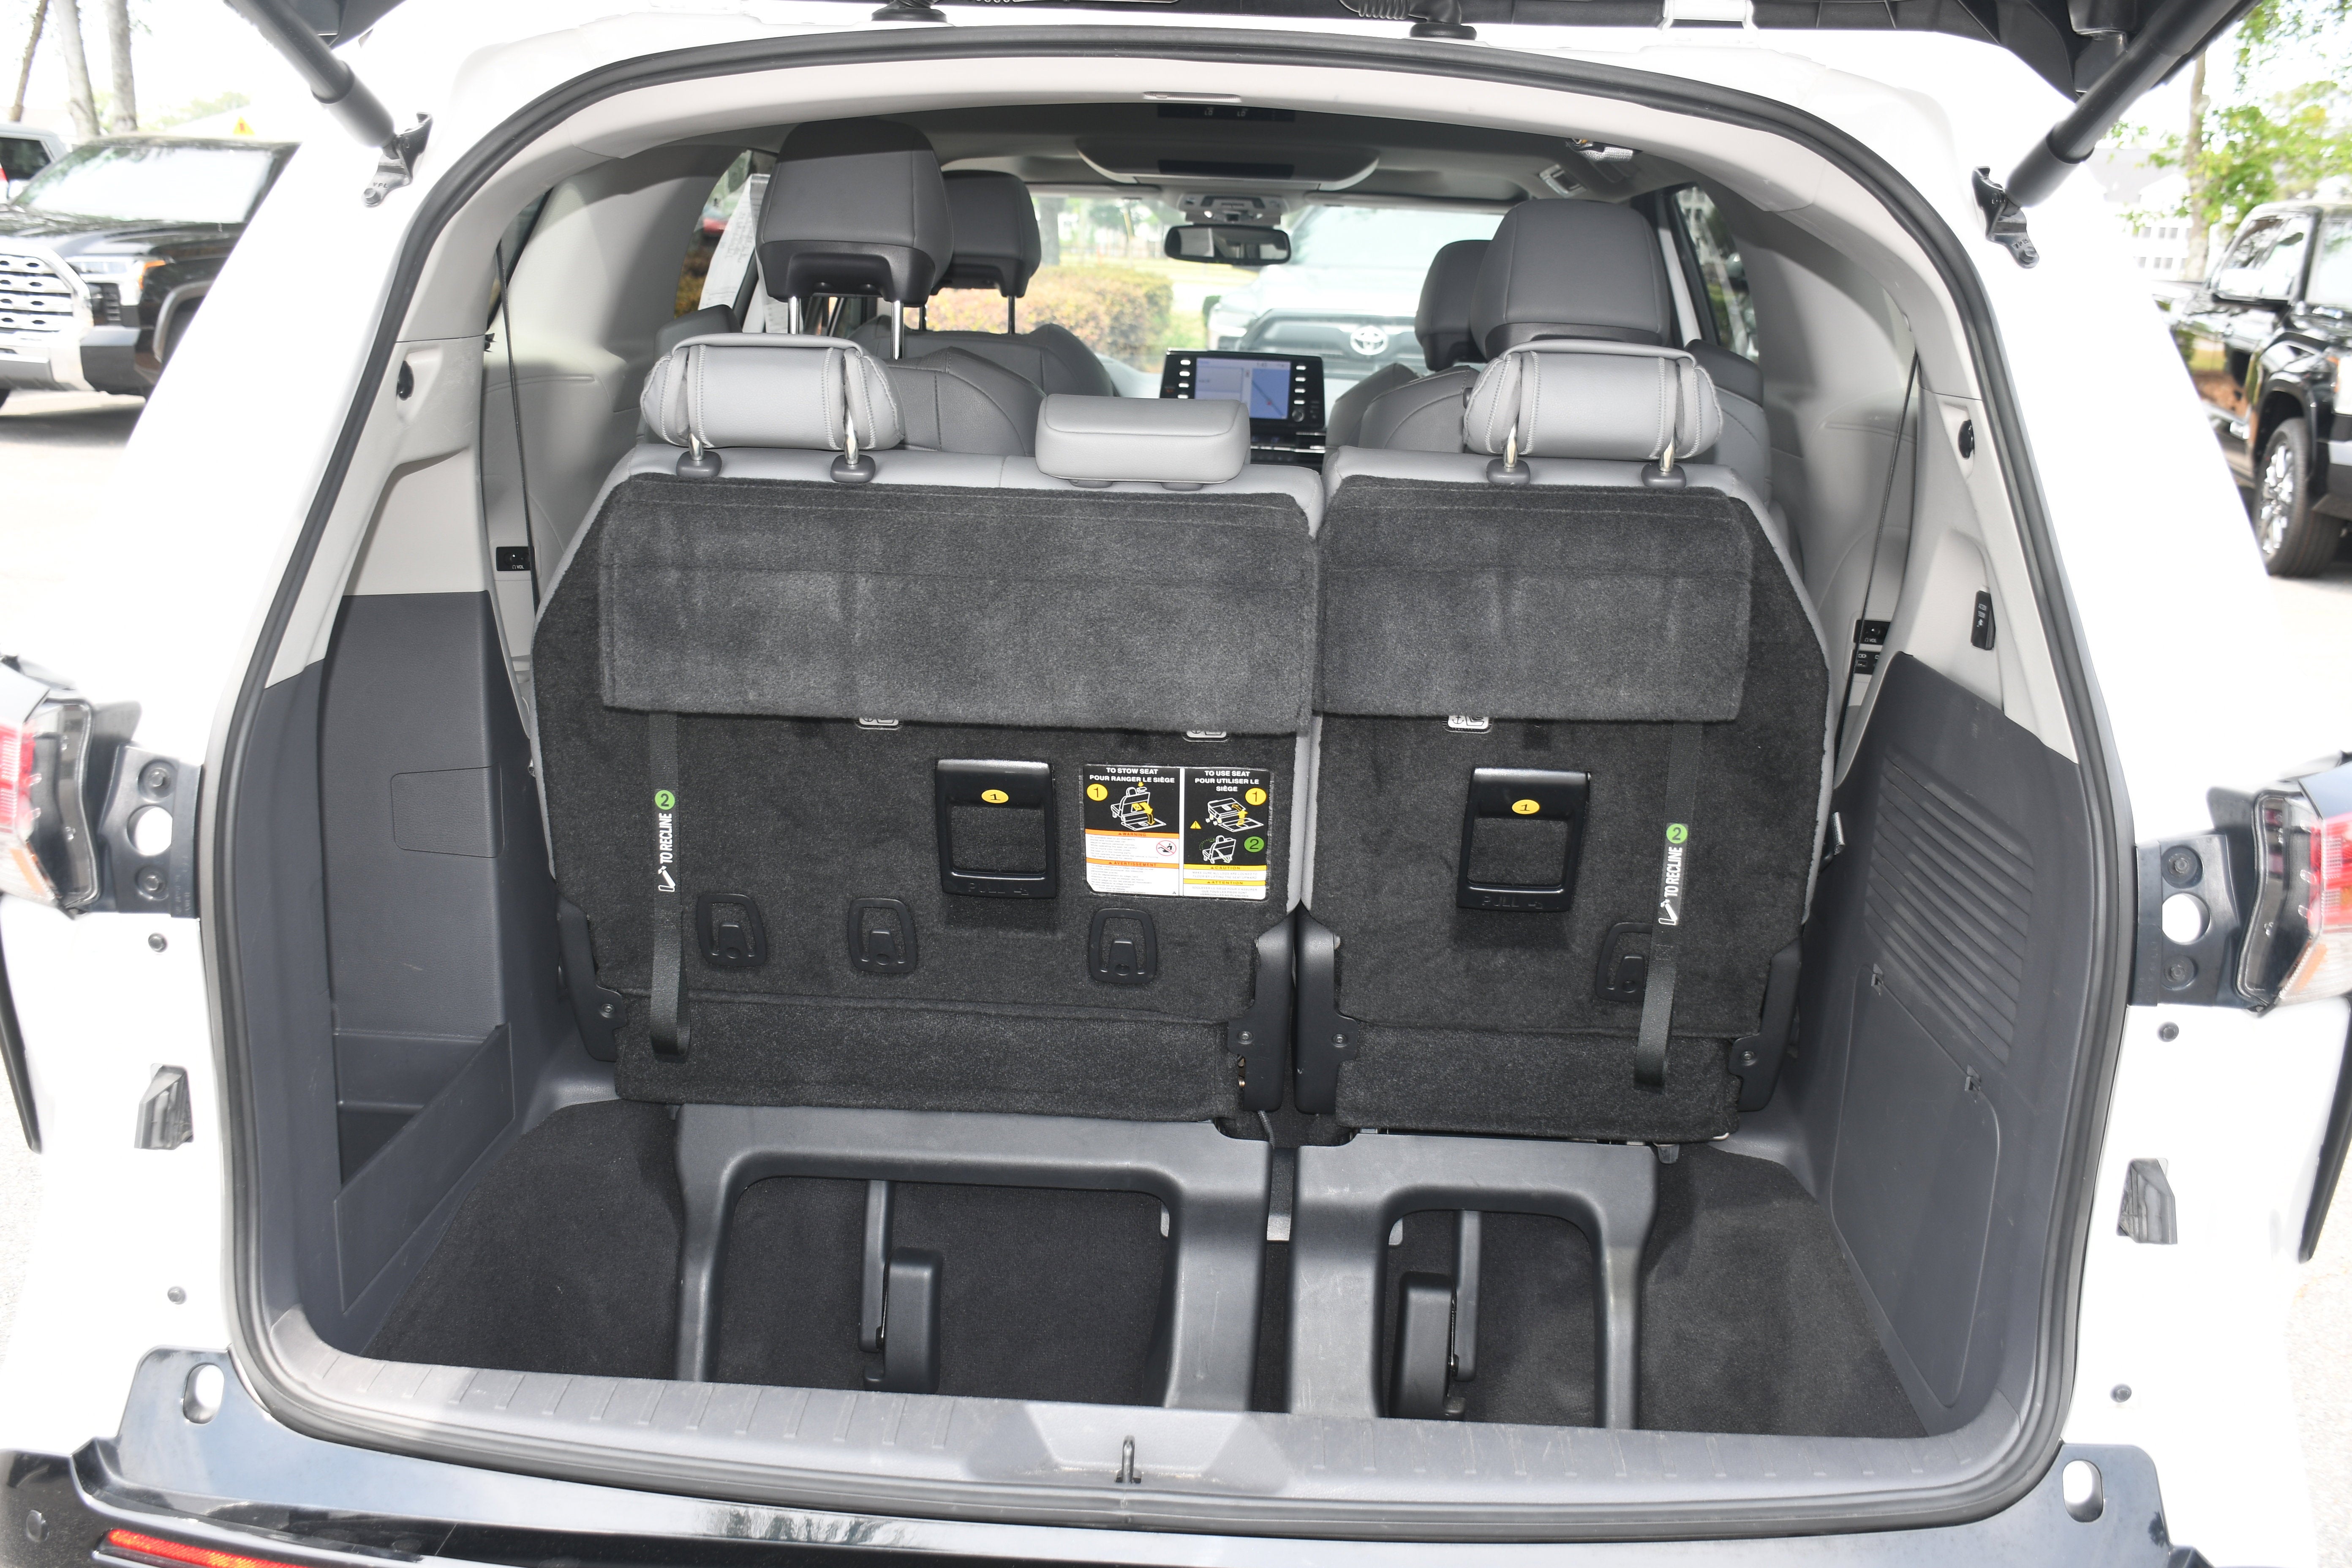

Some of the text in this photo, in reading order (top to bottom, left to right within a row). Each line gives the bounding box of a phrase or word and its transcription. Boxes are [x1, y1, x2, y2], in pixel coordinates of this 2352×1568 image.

[1093, 787, 1099, 798] 1
[1252, 791, 1258, 802] 1
[661, 793, 670, 807] 2
[659, 813, 673, 864] TO RECLINE
[1672, 827, 1681, 841] 2
[1249, 839, 1259, 849] 2
[1664, 847, 1682, 898] TO RECLINE
